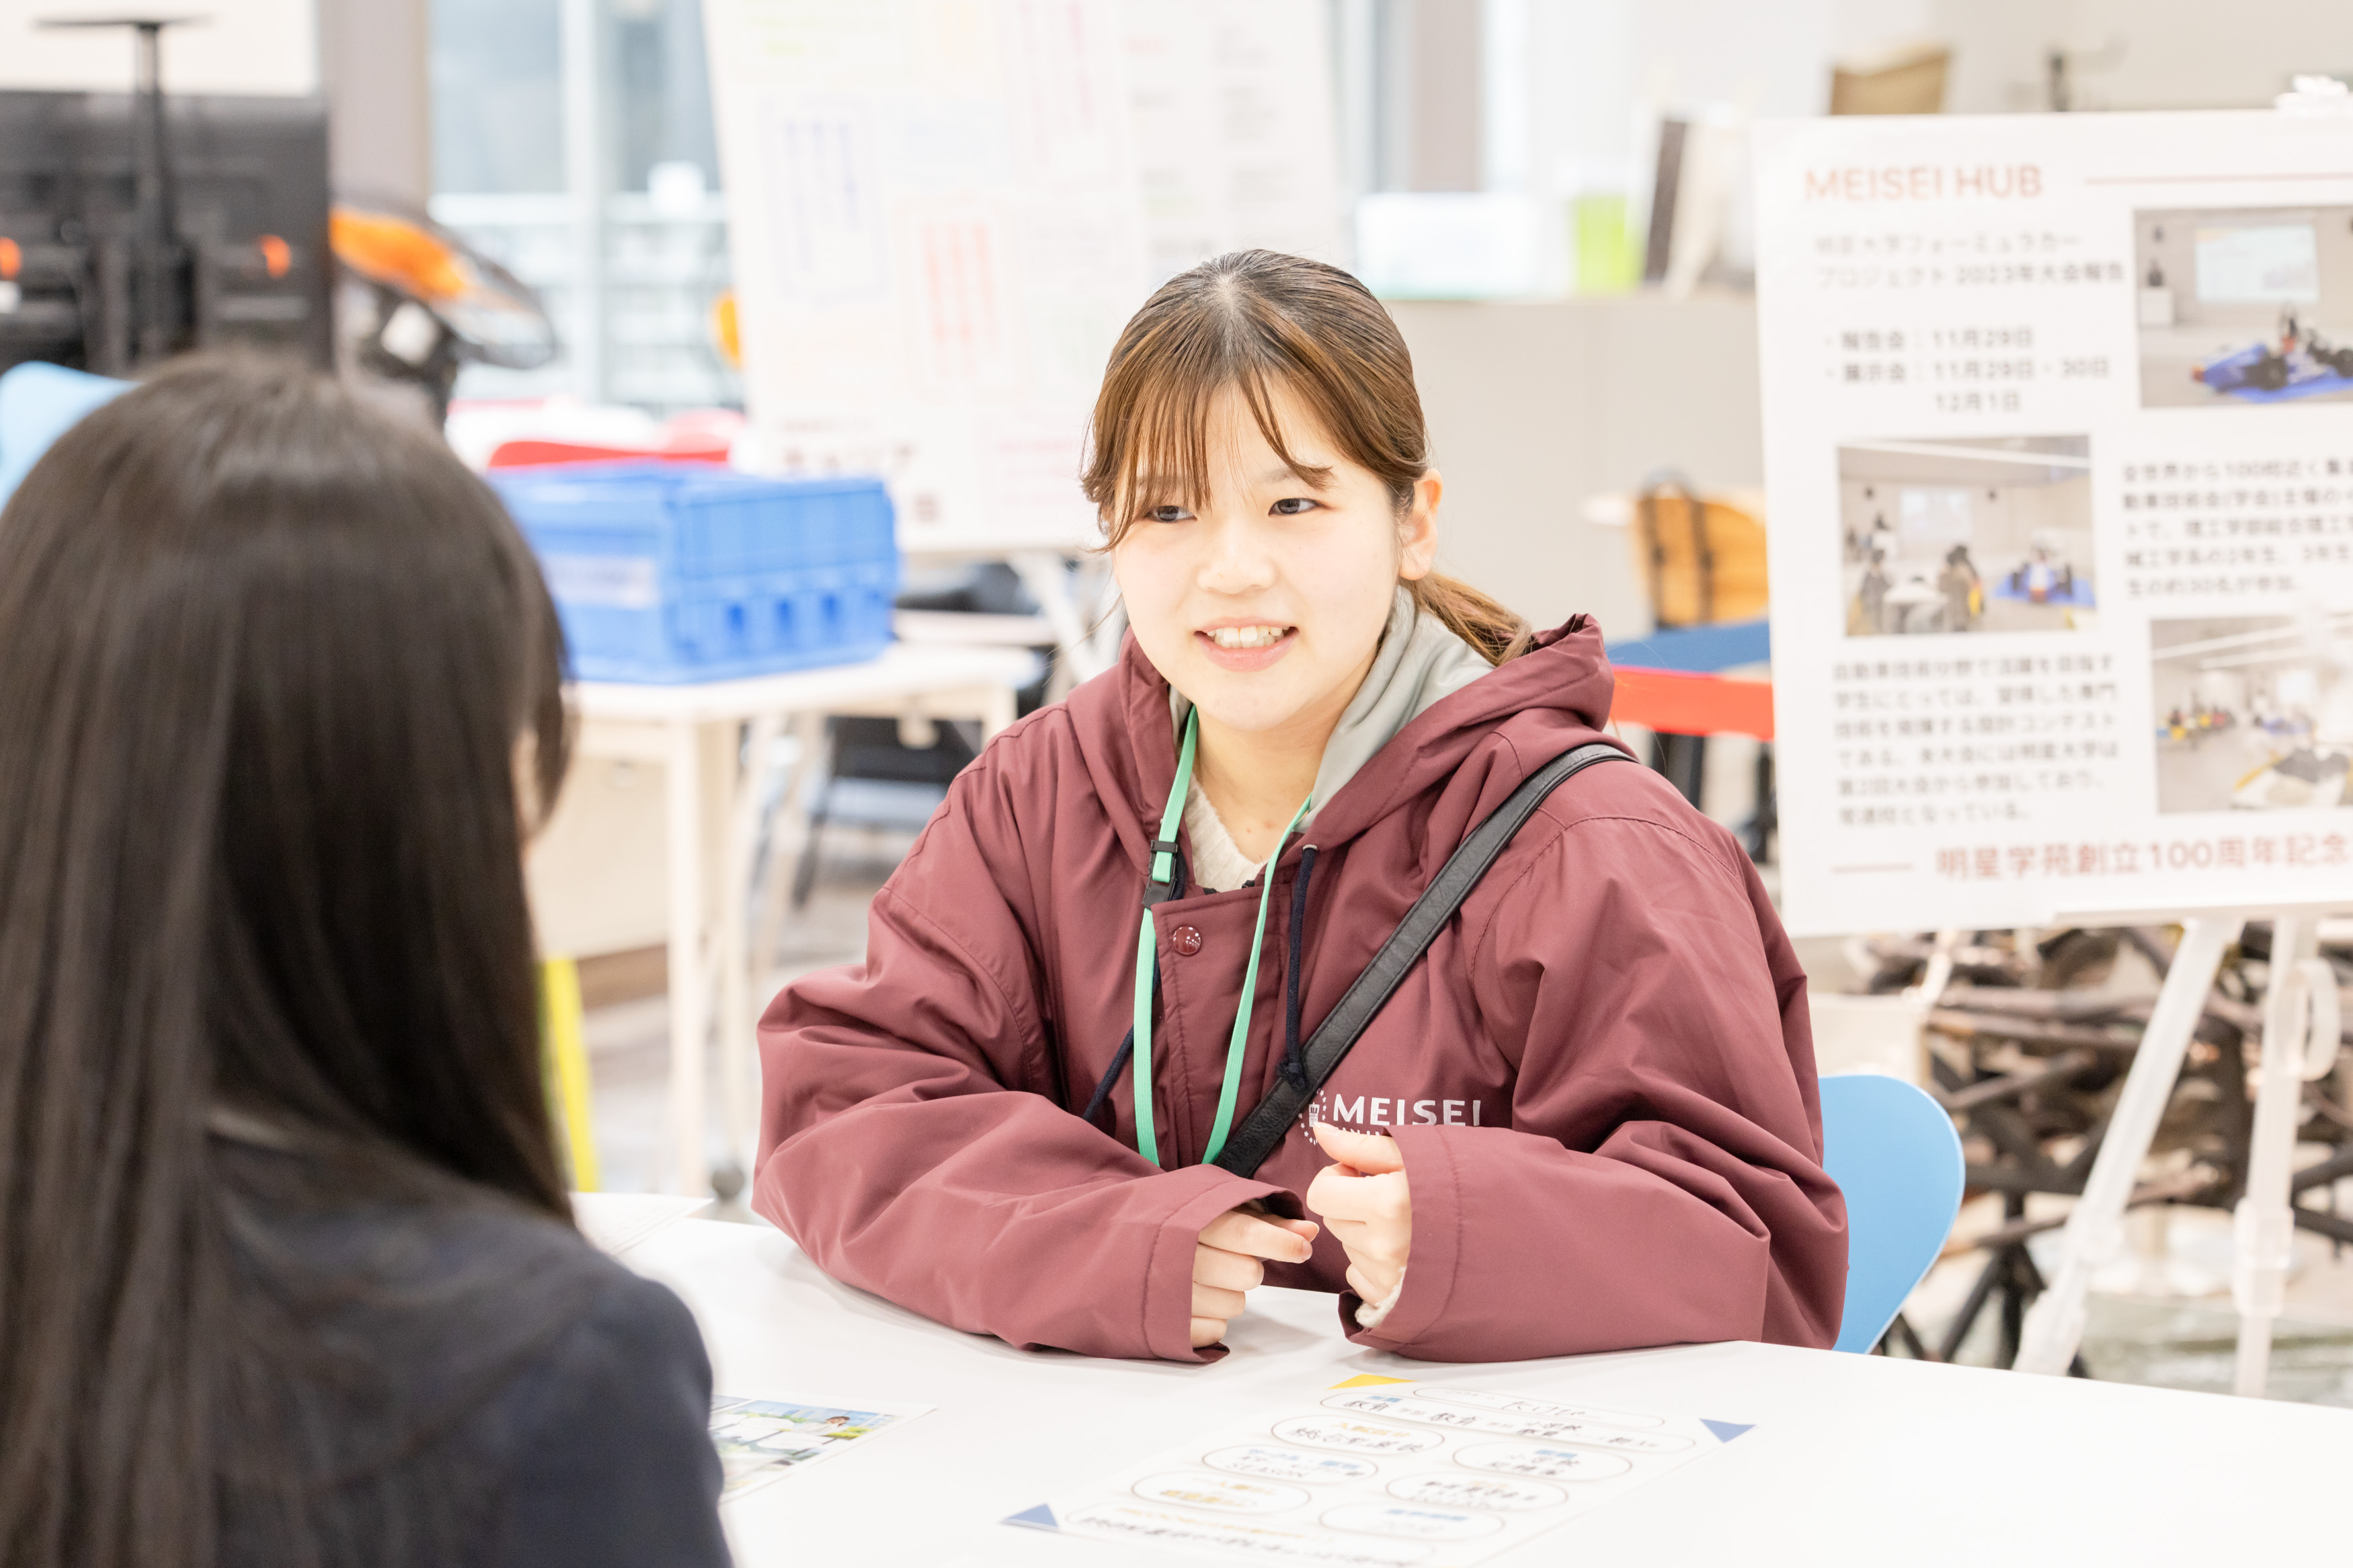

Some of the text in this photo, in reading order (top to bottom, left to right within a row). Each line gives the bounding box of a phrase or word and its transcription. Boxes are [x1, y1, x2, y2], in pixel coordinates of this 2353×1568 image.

[1805, 163, 2044, 202] MEISEI HUB
[1935, 388, 2021, 415] 12月1日
[1935, 833, 2352, 882] 明星学苑創立100周年記念
[1333, 1094, 1481, 1126] MEISEI
